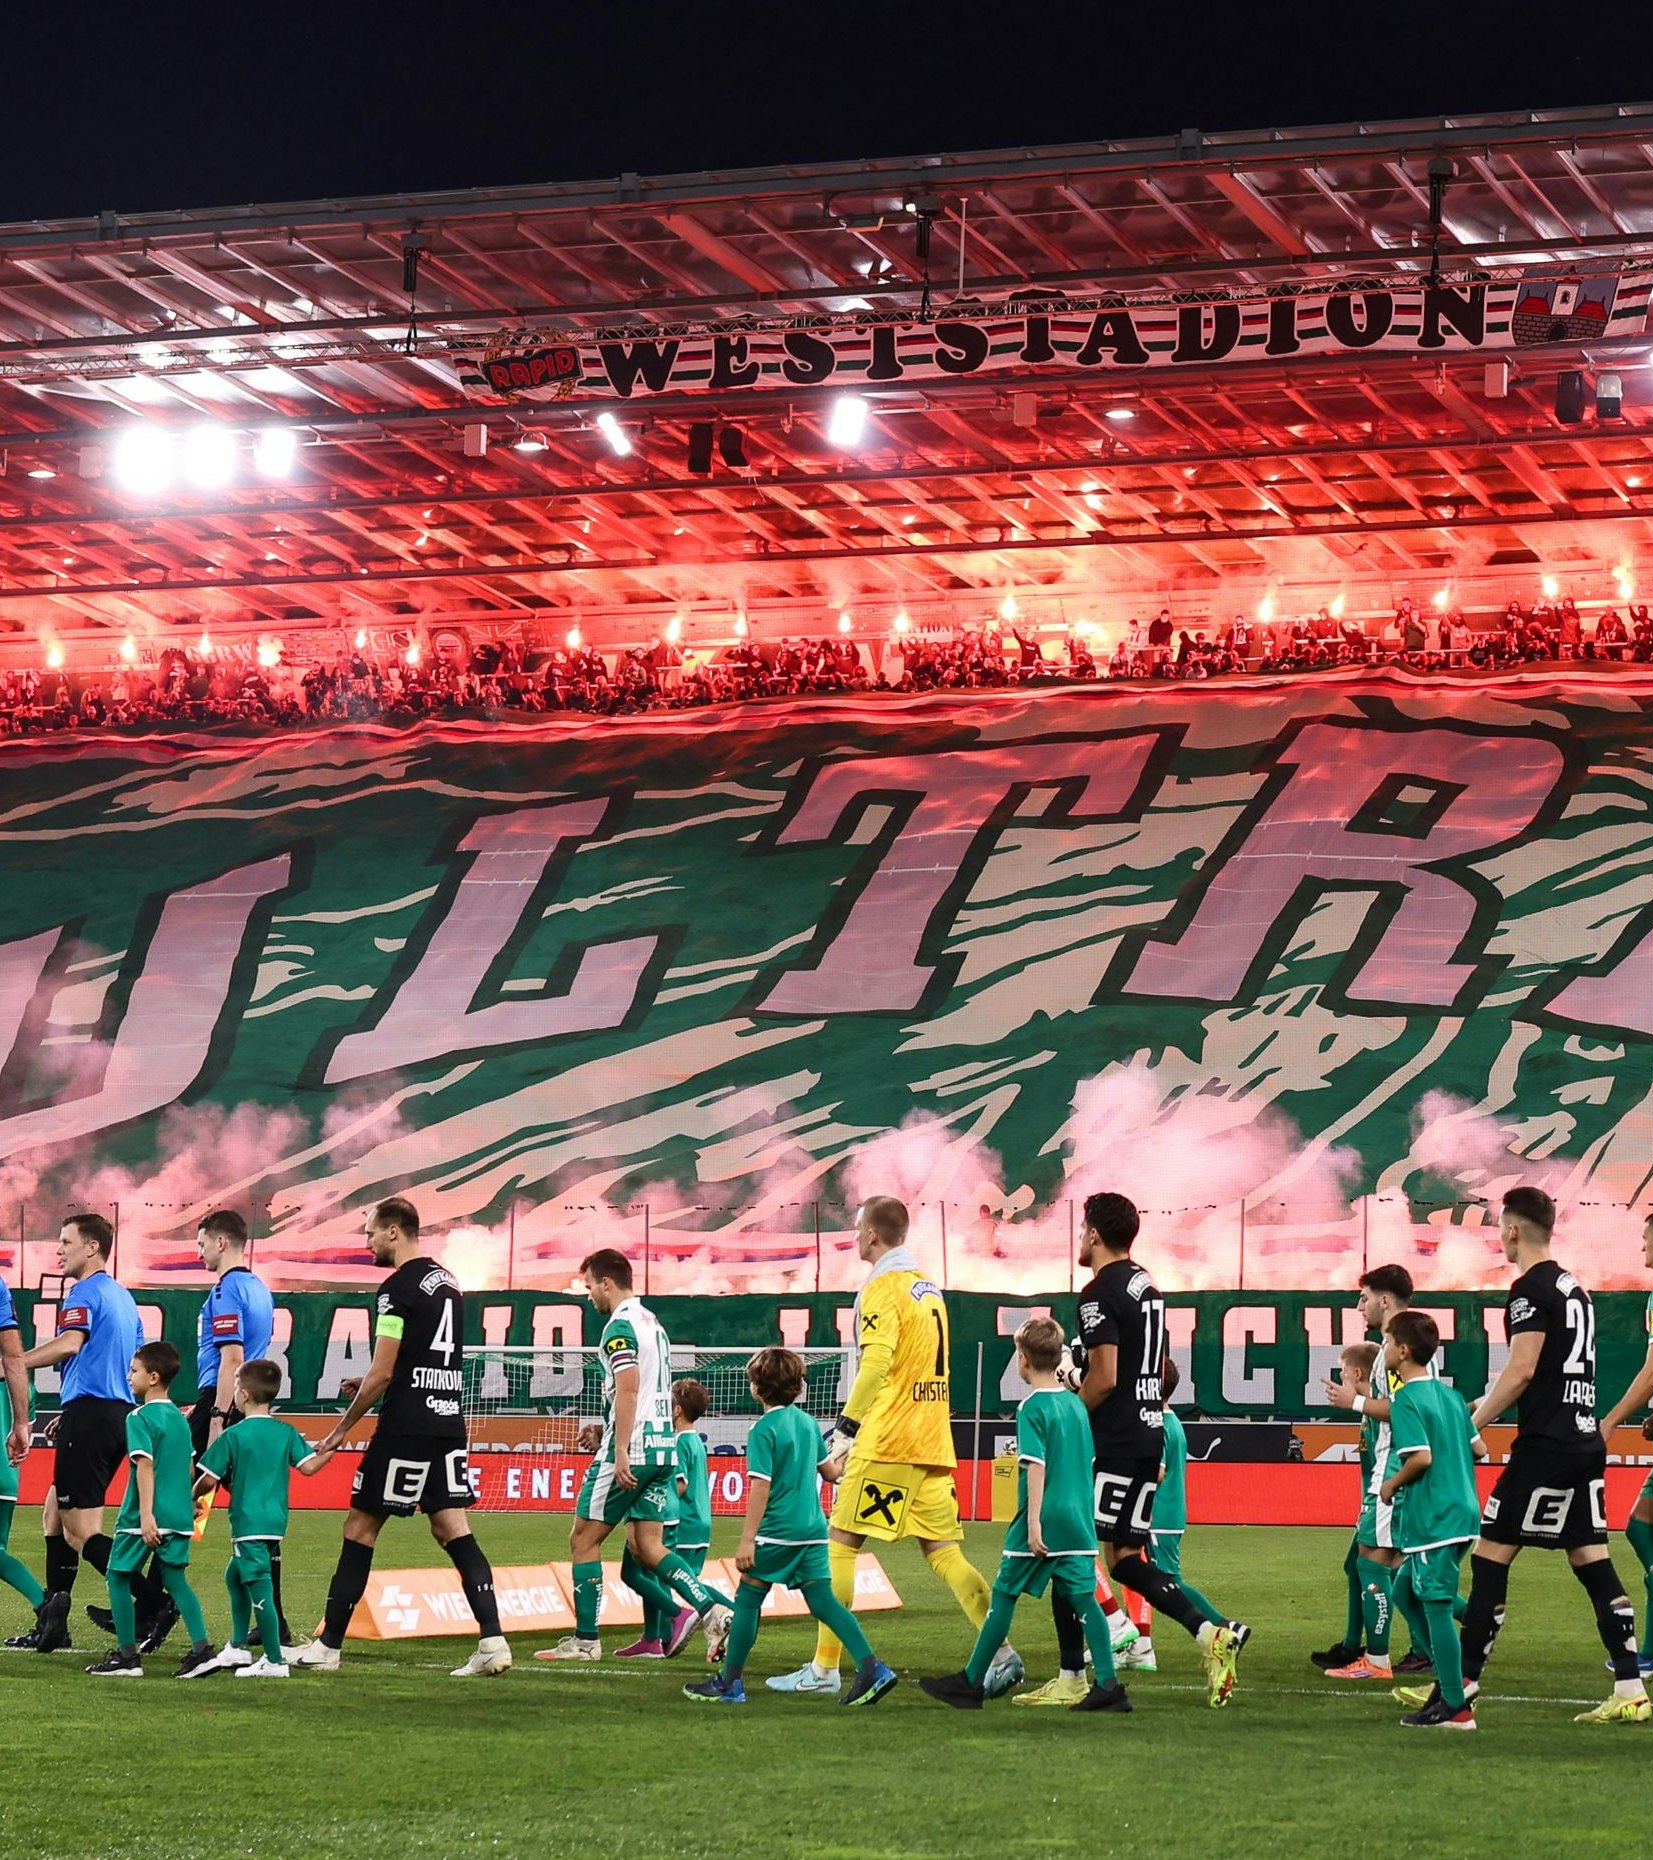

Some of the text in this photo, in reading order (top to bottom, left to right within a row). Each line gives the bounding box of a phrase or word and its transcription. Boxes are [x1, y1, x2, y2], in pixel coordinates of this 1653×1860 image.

[598, 272, 1488, 397] WESTSTADION
[489, 351, 574, 388] RAPID
[430, 1298, 454, 1367] 4
[931, 1308, 945, 1377] 1
[1141, 1299, 1164, 1374] 17
[1562, 1298, 1596, 1378] 24
[411, 1366, 463, 1391] STANKOVI
[1374, 1592, 1389, 1636] easystaff
